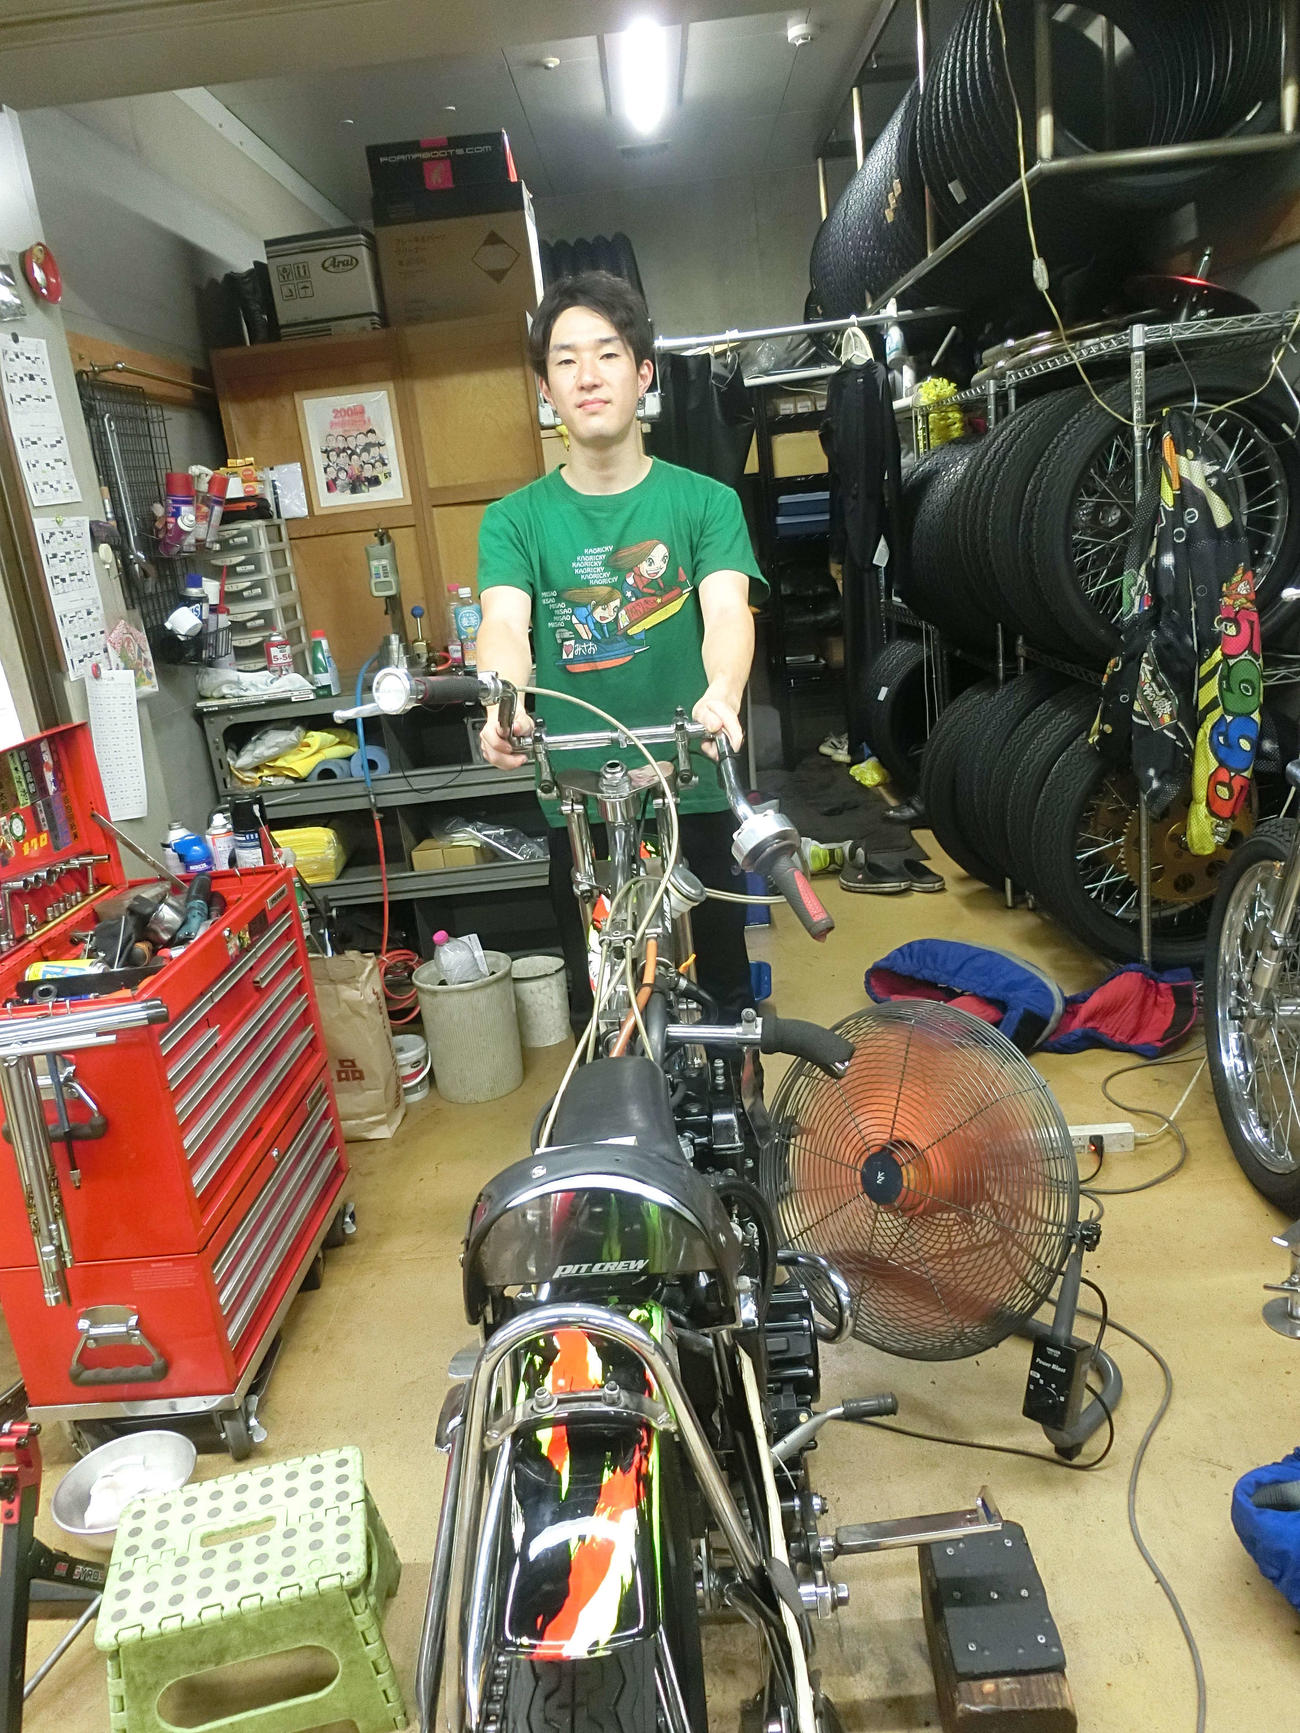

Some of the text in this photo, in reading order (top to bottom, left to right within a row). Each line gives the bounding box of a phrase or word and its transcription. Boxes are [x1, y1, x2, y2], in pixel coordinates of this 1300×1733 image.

[379, 145, 493, 164] FORMABOOTS.COM
[326, 255, 357, 270] Arai
[574, 567, 605, 575] KAORICKY
[574, 641, 598, 656] みさお
[552, 1259, 650, 1279] PIT CREW
